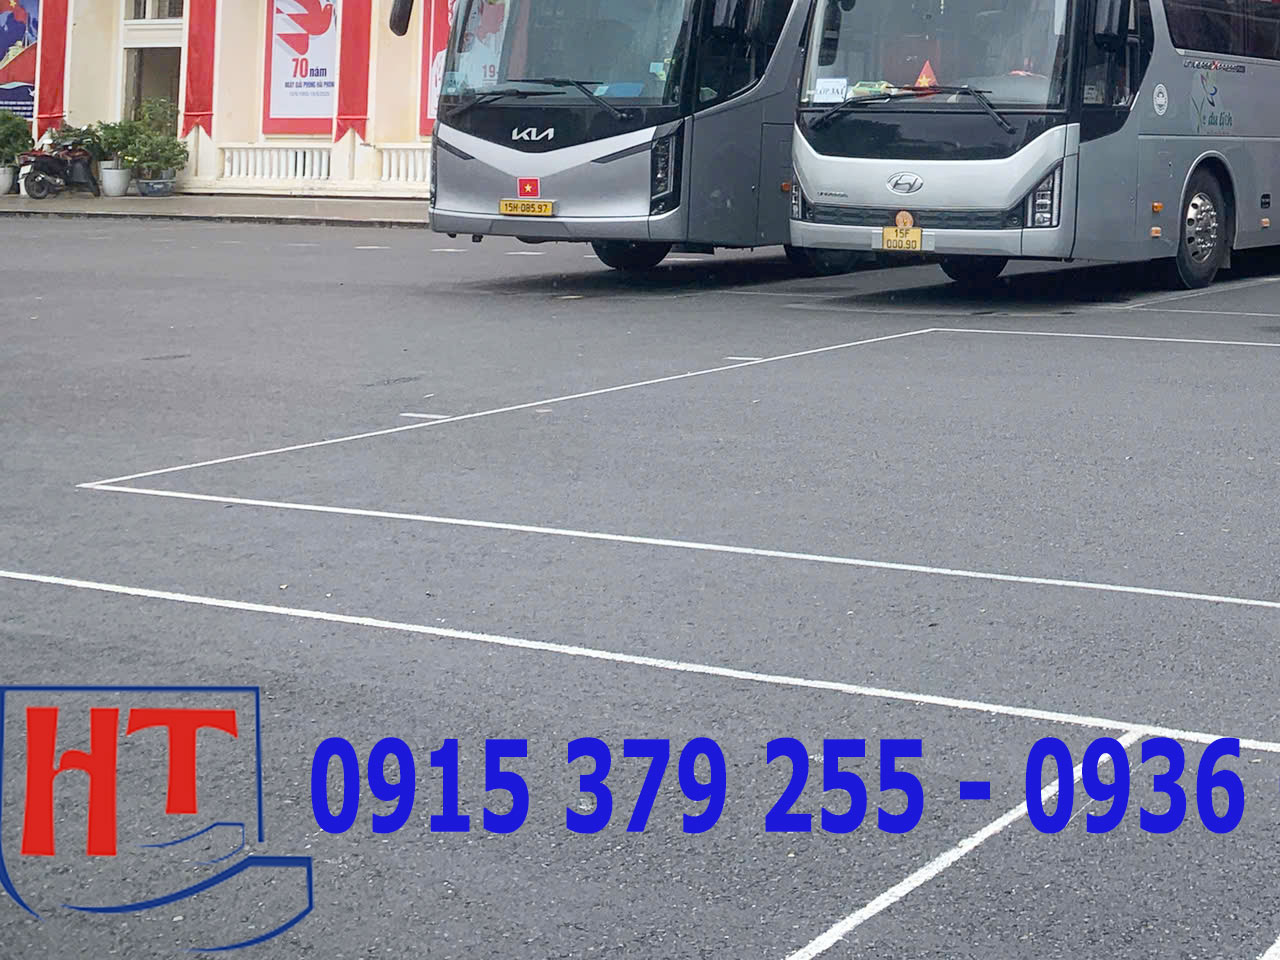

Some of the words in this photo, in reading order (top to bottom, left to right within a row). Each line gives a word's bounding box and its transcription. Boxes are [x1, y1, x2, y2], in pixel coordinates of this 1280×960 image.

[292, 57, 309, 78] 70
[511, 127, 555, 141] KIA
[504, 202, 548, 213] 15H-085.97
[894, 228, 910, 238] 15F
[886, 239, 917, 250] 000.90
